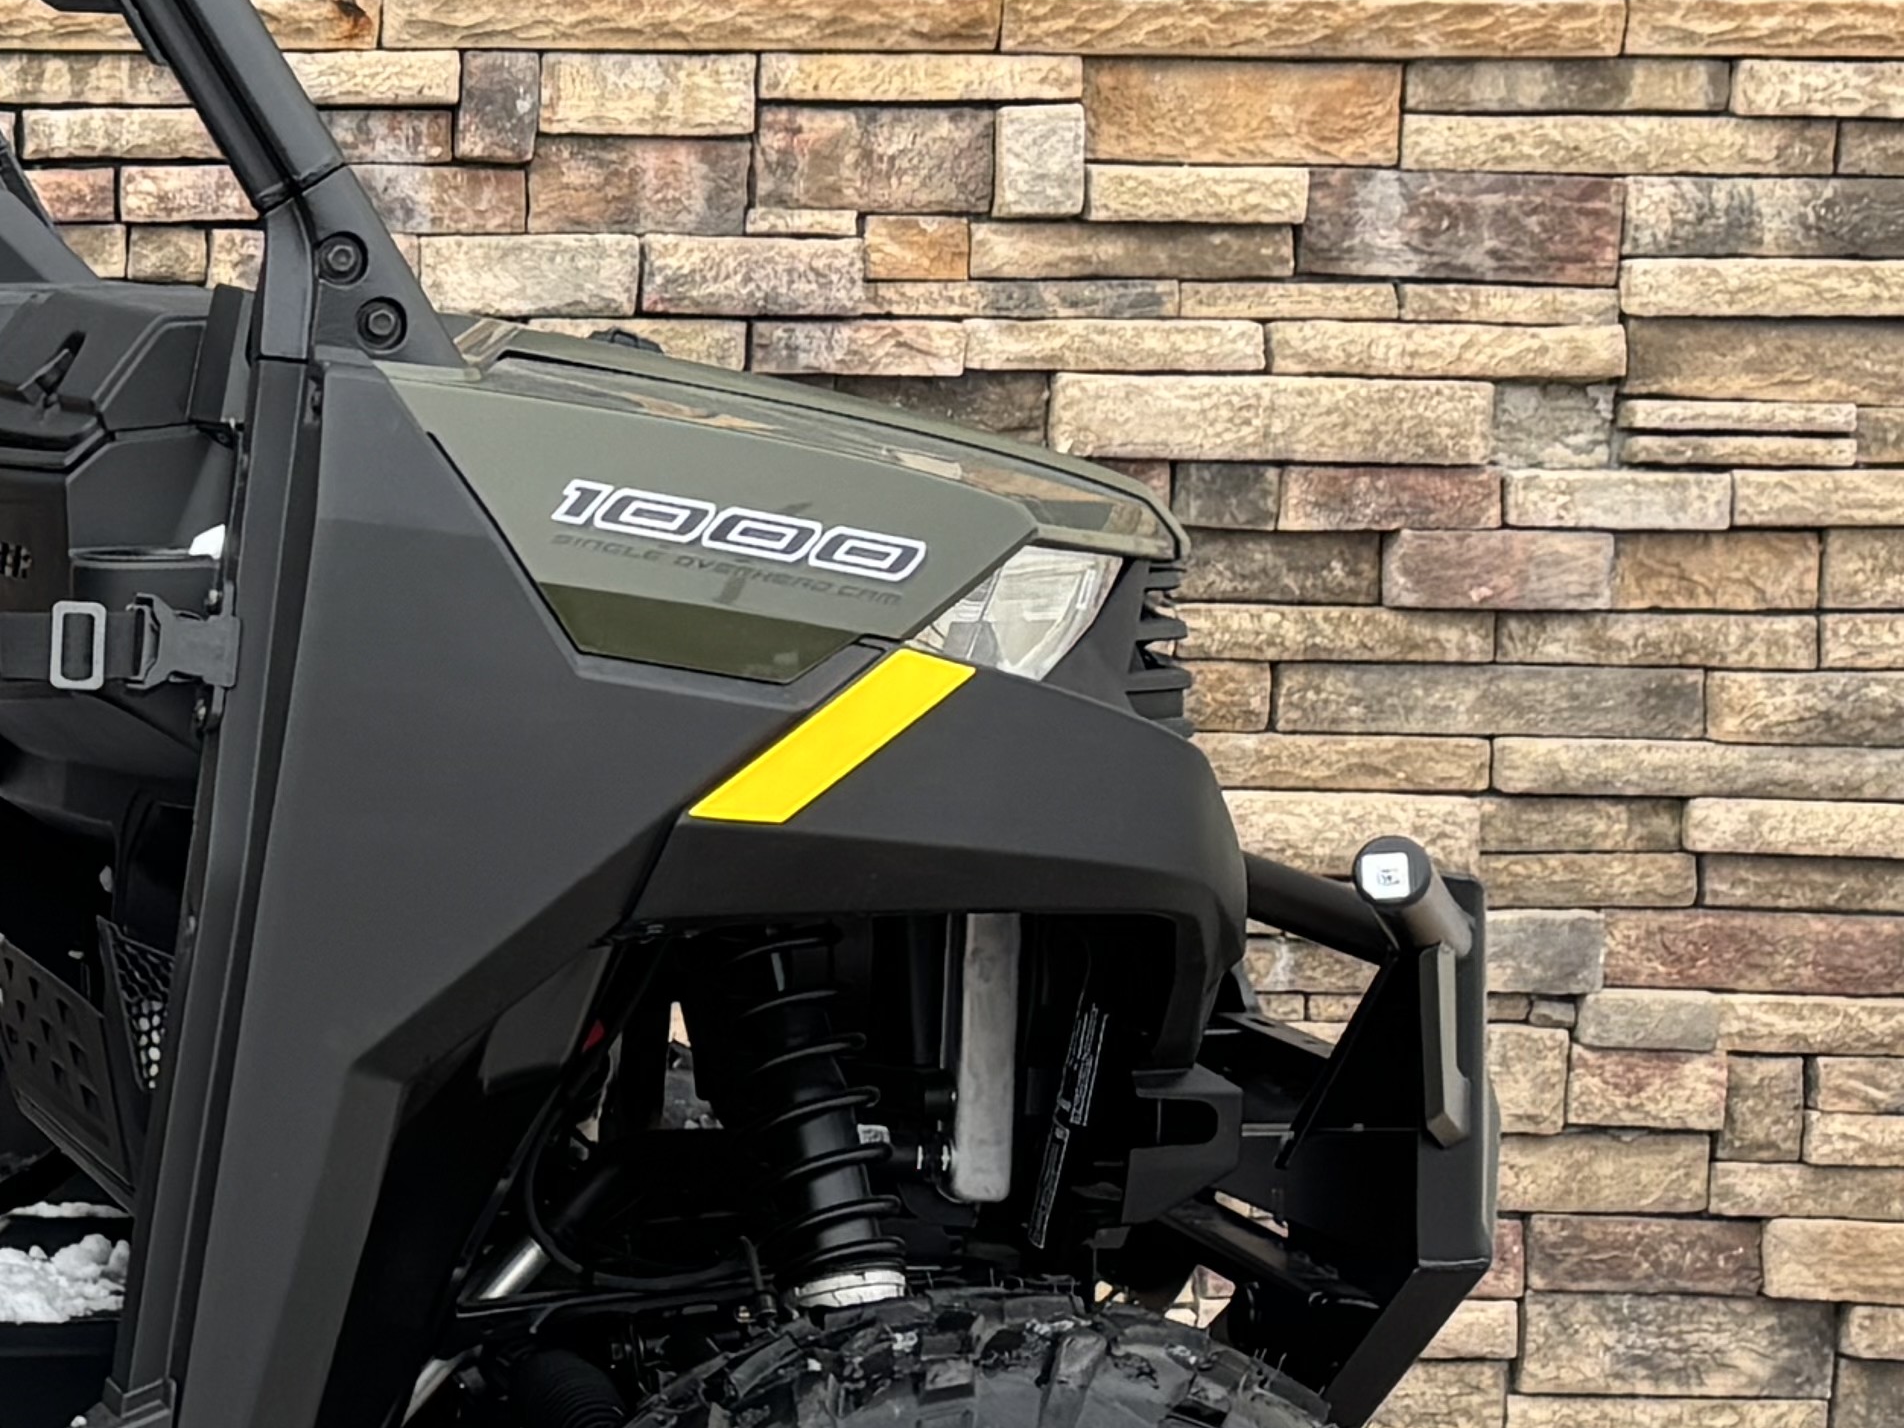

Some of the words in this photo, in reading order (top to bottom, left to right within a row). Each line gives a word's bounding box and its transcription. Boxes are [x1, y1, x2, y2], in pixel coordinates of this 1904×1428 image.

[550, 478, 927, 582] 1000
[550, 533, 662, 562] SINGLE
[837, 583, 903, 607] CAM
